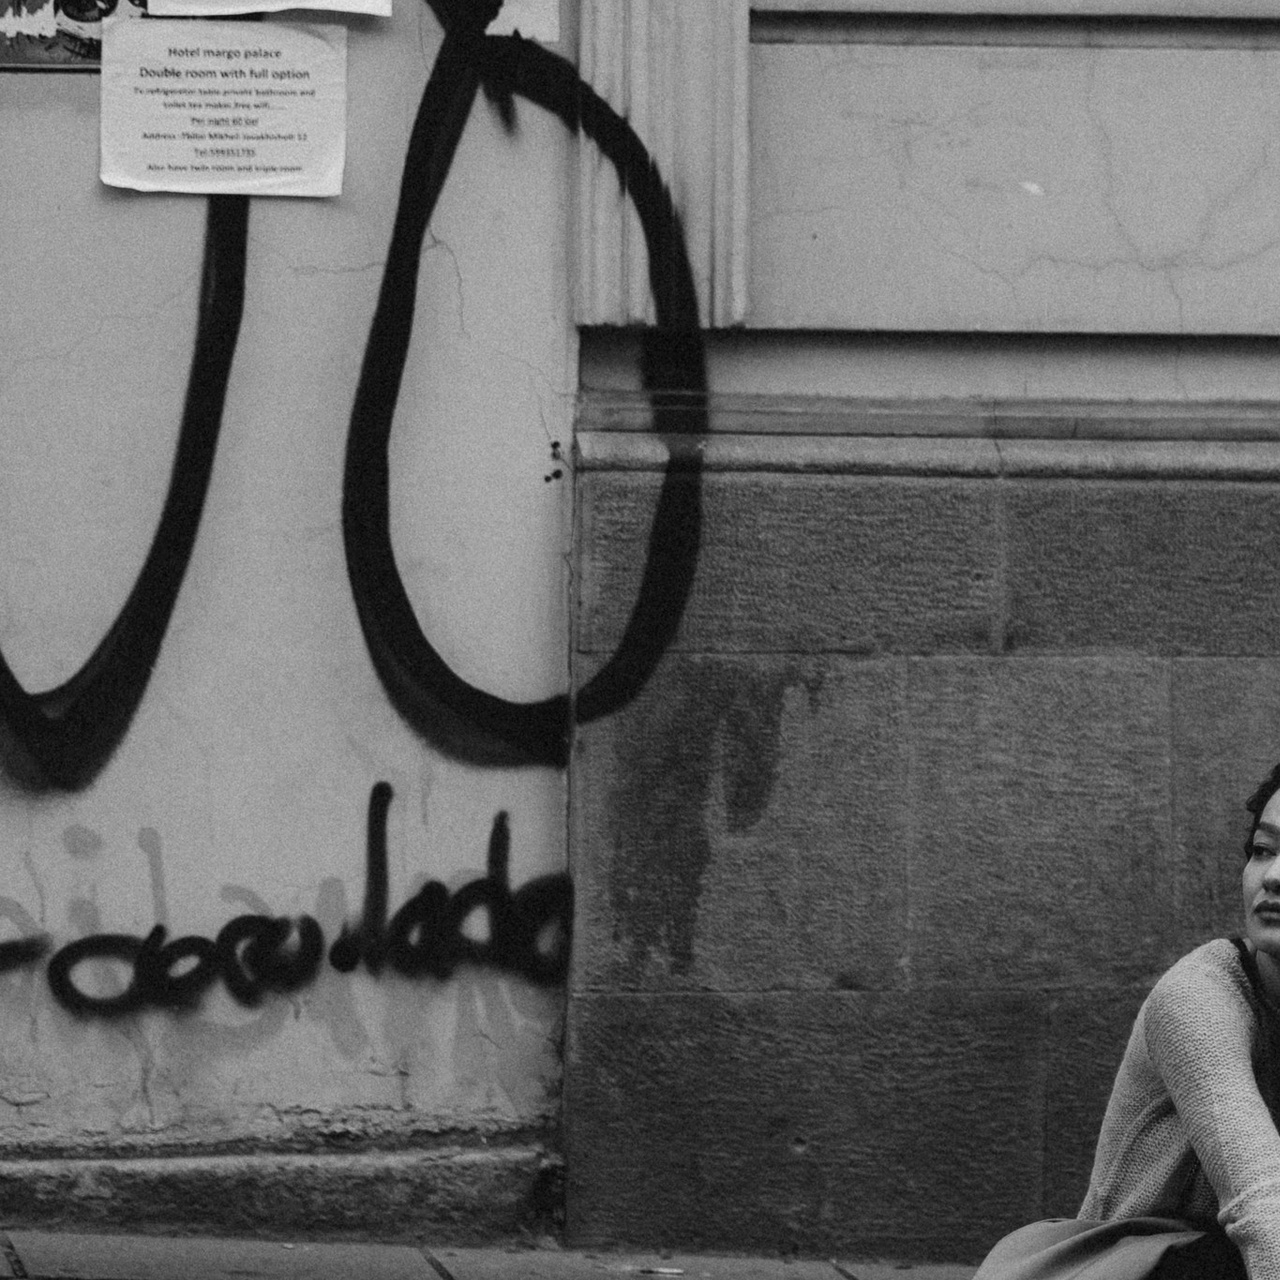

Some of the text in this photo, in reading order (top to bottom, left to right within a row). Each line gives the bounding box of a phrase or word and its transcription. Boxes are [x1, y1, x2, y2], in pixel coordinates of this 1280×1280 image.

[169, 48, 282, 59] Hotel margo palace
[140, 67, 310, 81] Double room with full option
